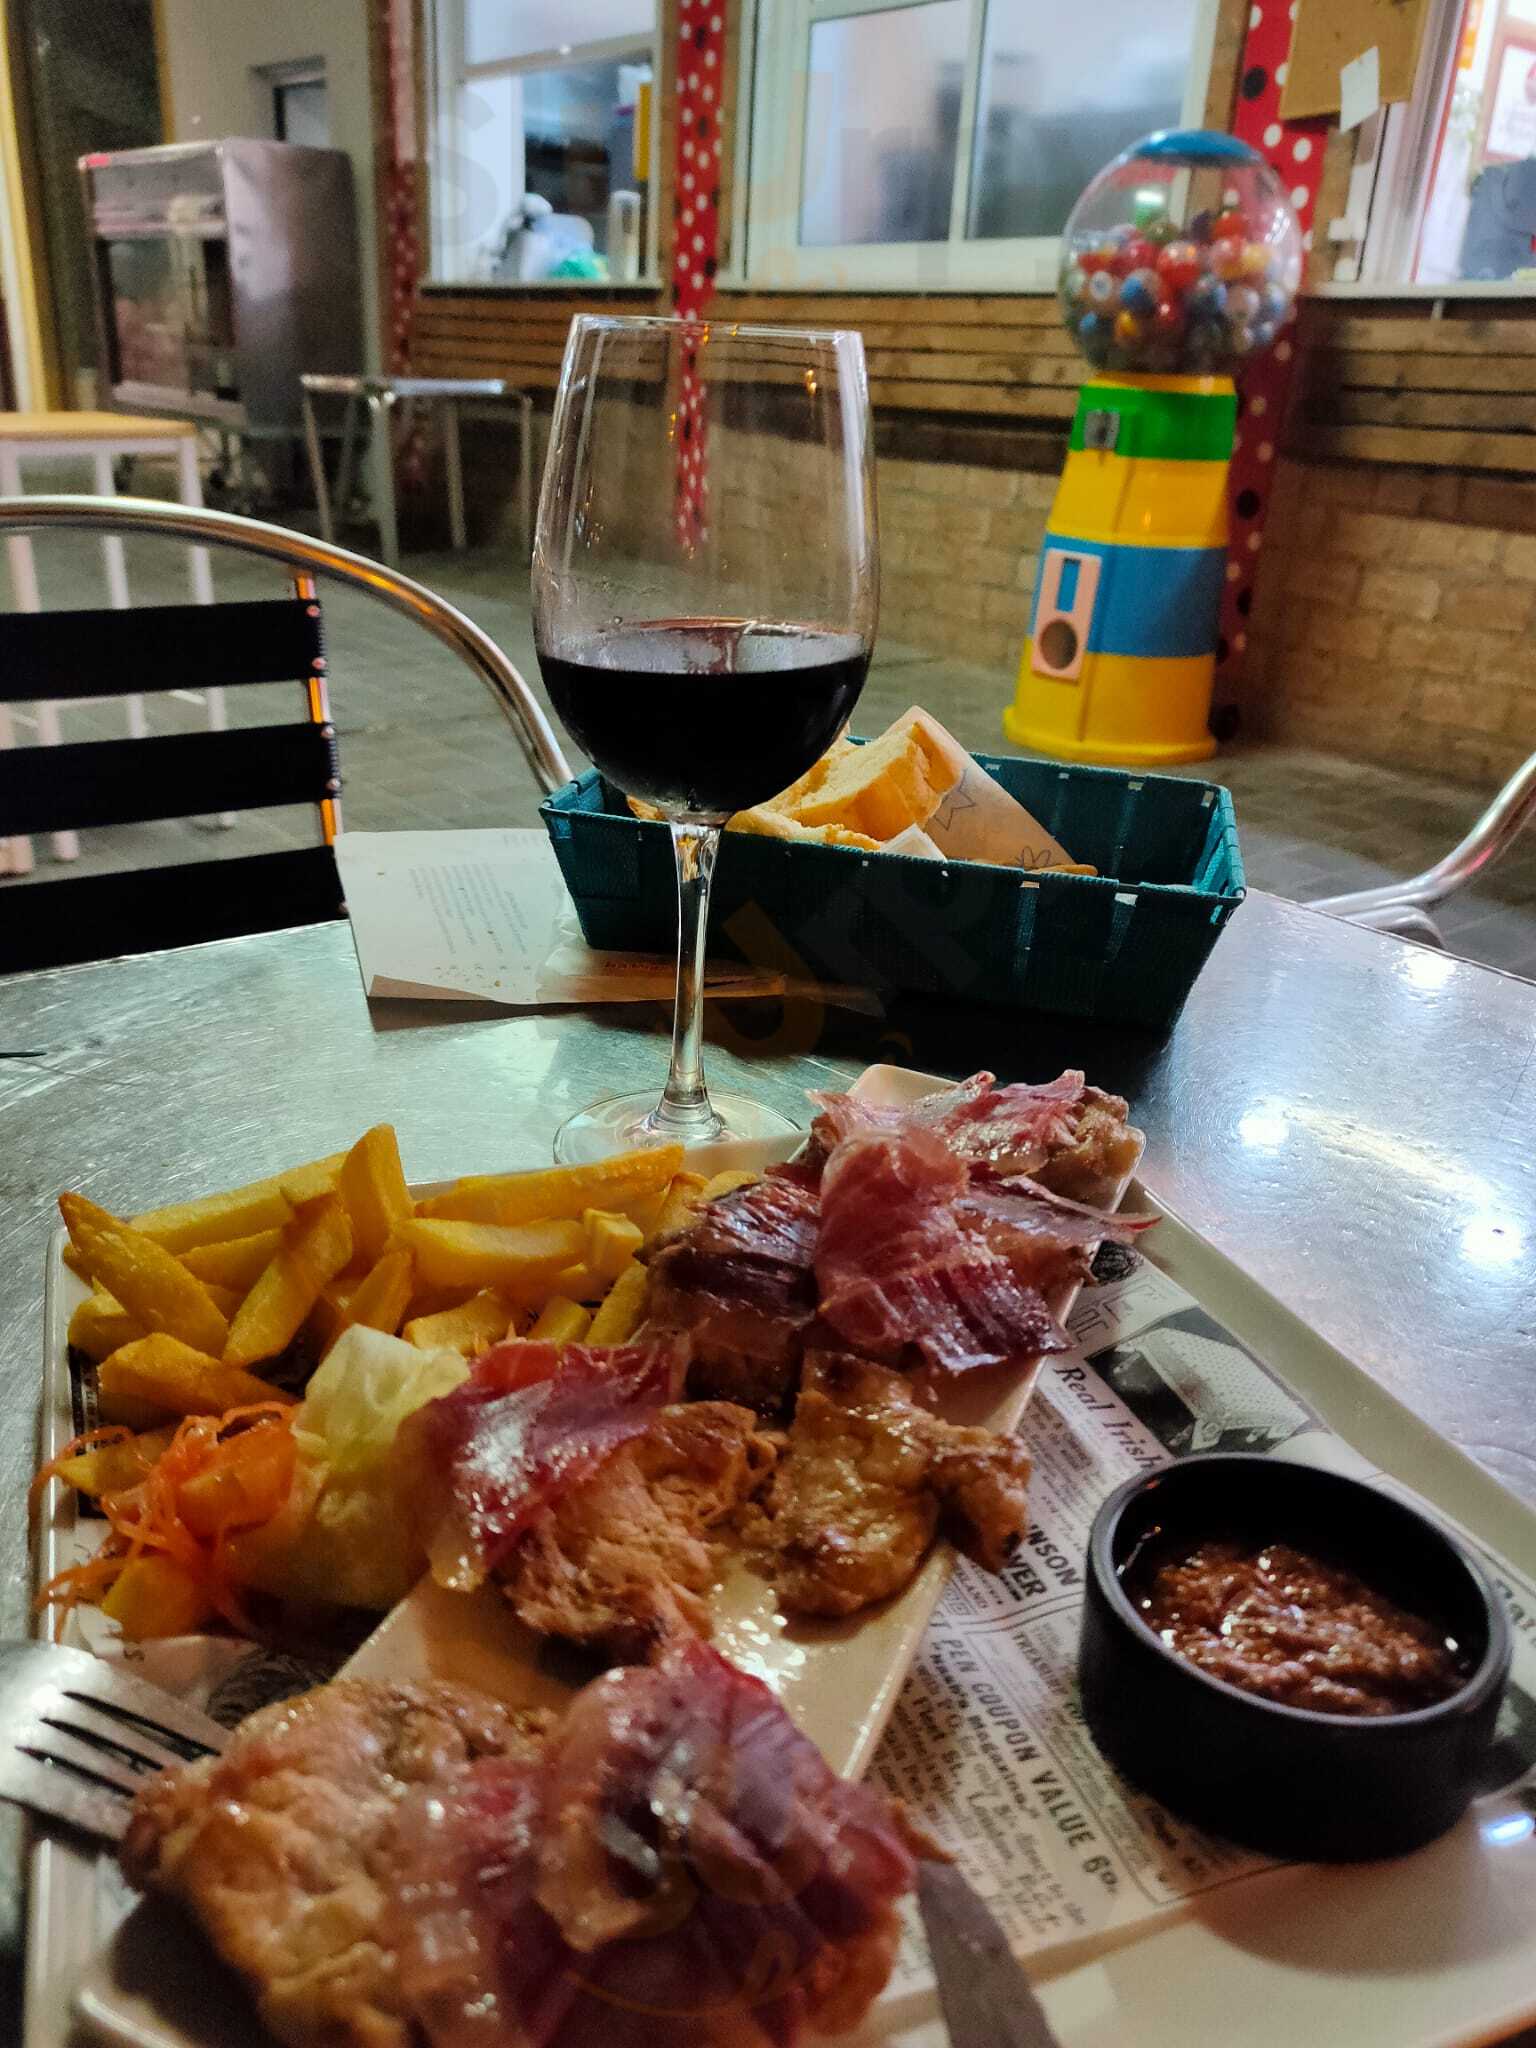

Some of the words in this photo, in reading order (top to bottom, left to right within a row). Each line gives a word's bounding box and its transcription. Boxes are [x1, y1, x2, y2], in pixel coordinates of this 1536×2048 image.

[1053, 1367, 1115, 1412] Real
[1103, 1420, 1163, 1469] Irish
[1008, 1553, 1047, 1597] VER
[940, 1639, 978, 1673] PEN
[971, 1683, 1040, 1762] COUPON
[1031, 1770, 1096, 1847] VALUE
